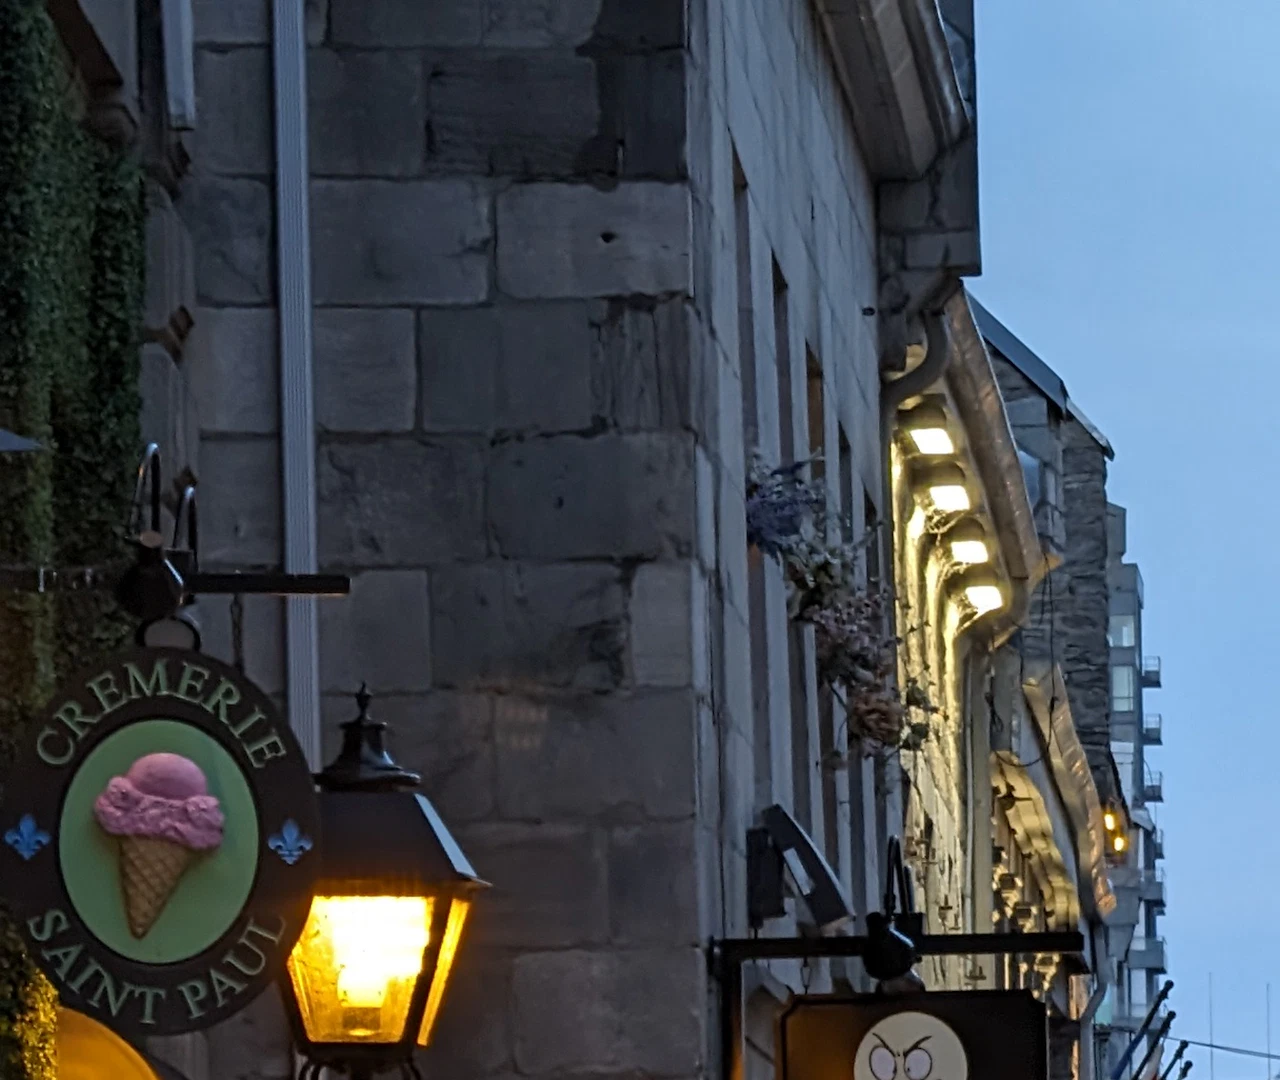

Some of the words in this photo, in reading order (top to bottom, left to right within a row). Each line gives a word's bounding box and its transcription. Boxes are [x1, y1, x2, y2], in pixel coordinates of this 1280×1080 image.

[37, 658, 287, 769] CREMERIE
[27, 908, 166, 1025] SAINT
[177, 915, 287, 1020] PAUL
